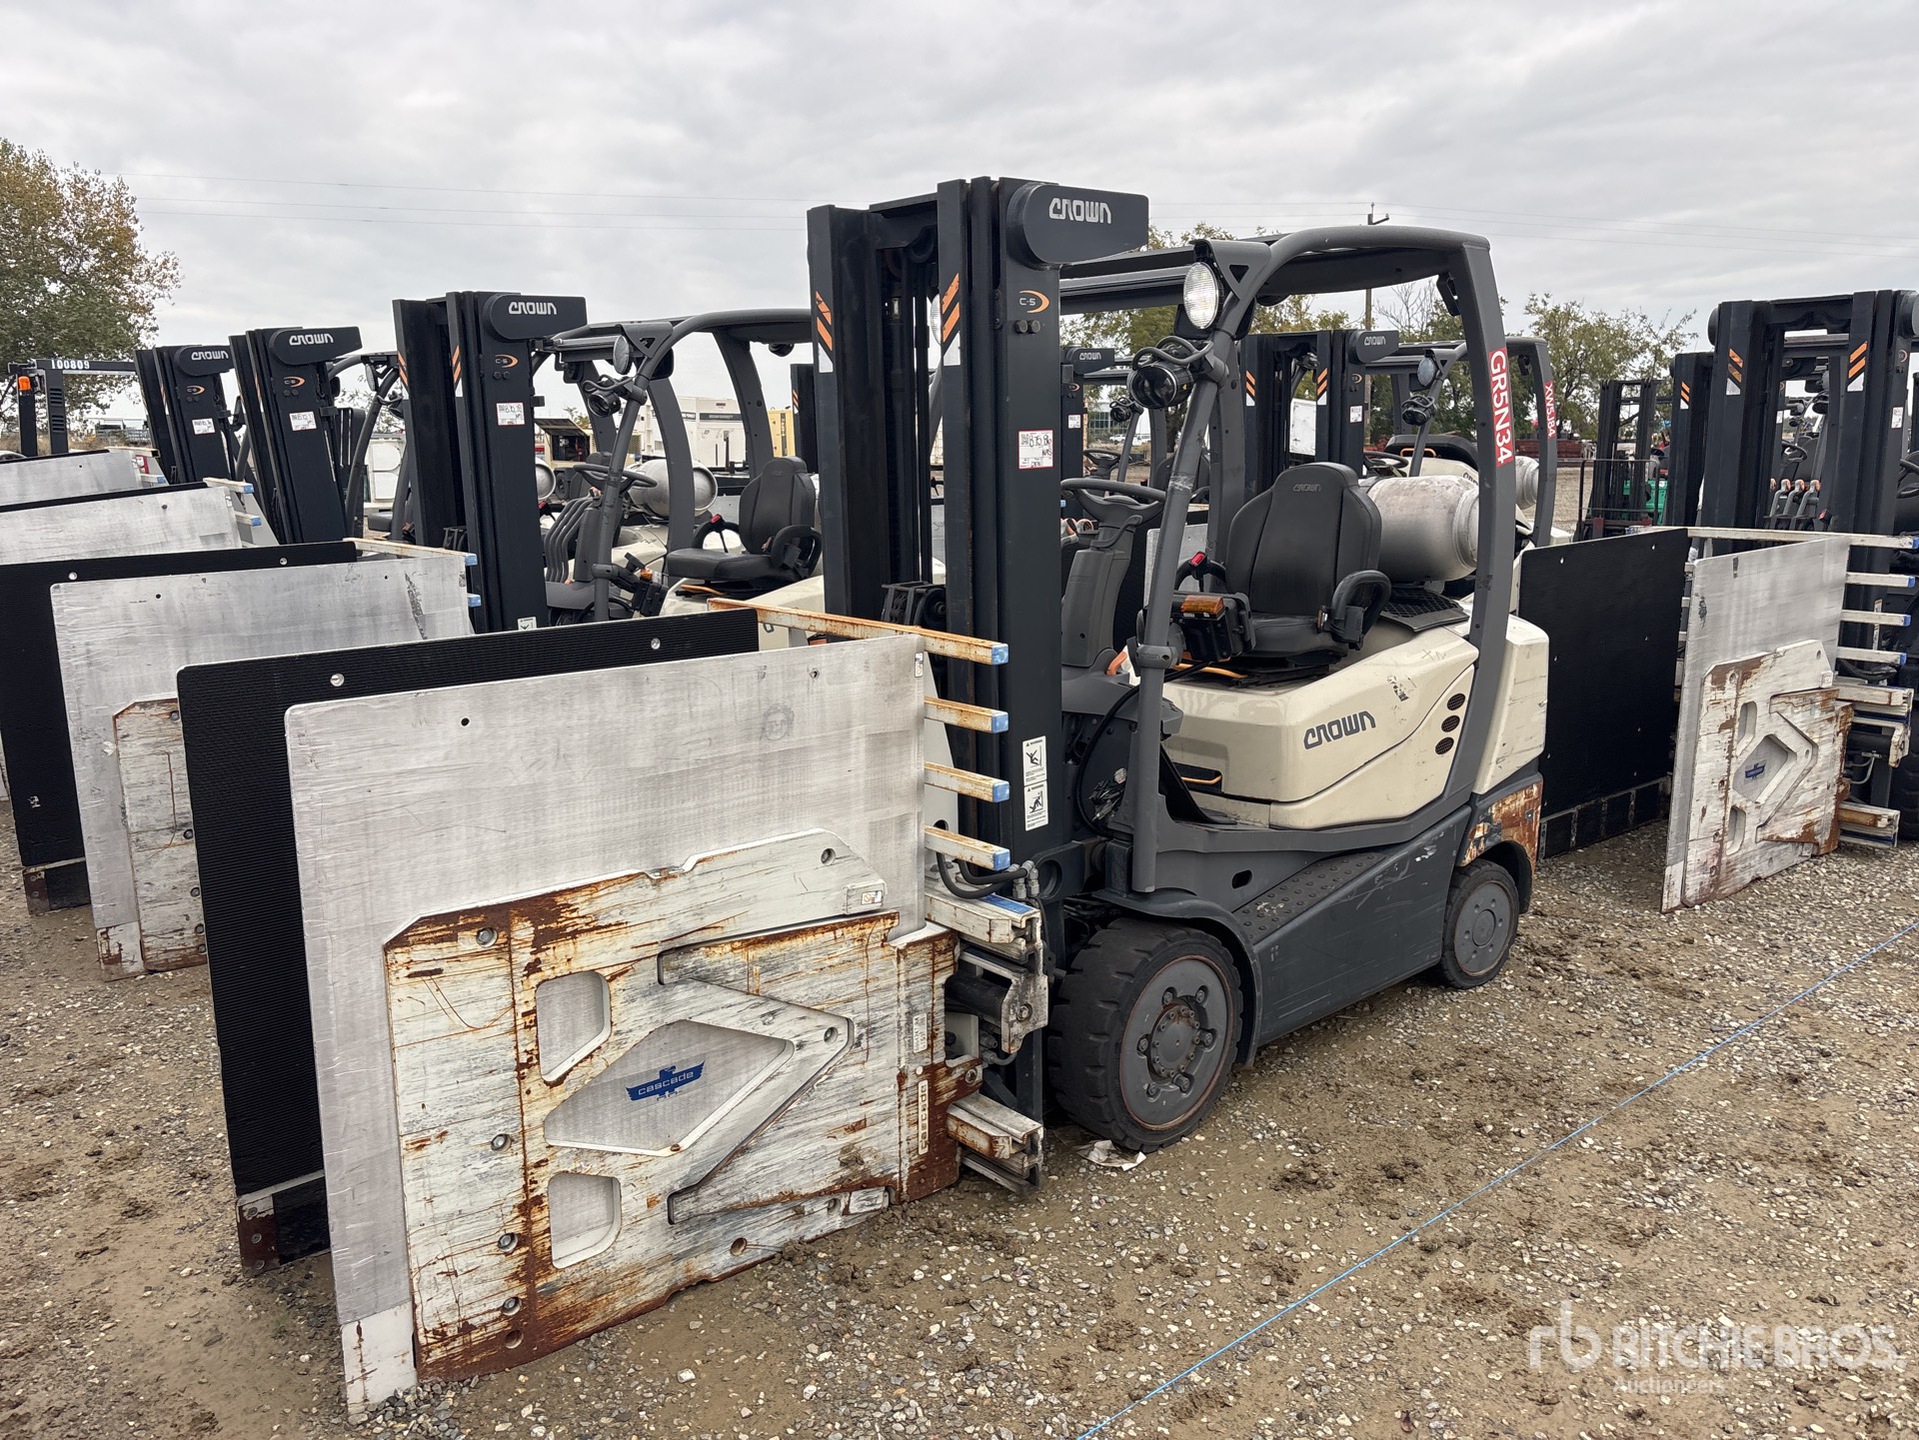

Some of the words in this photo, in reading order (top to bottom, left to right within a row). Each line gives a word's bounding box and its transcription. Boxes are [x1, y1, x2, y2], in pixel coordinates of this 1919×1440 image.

[1048, 197, 1112, 224] CROWN
[508, 301, 557, 315] CROWN
[288, 333, 334, 346] CROWN
[1364, 335, 1386, 346] CROWN
[191, 350, 229, 360] CROWN
[51, 358, 90, 370] 100809
[1490, 350, 1513, 464] GR5N34
[1303, 710, 1377, 750] CROWN
[637, 1071, 694, 1096] cascade
